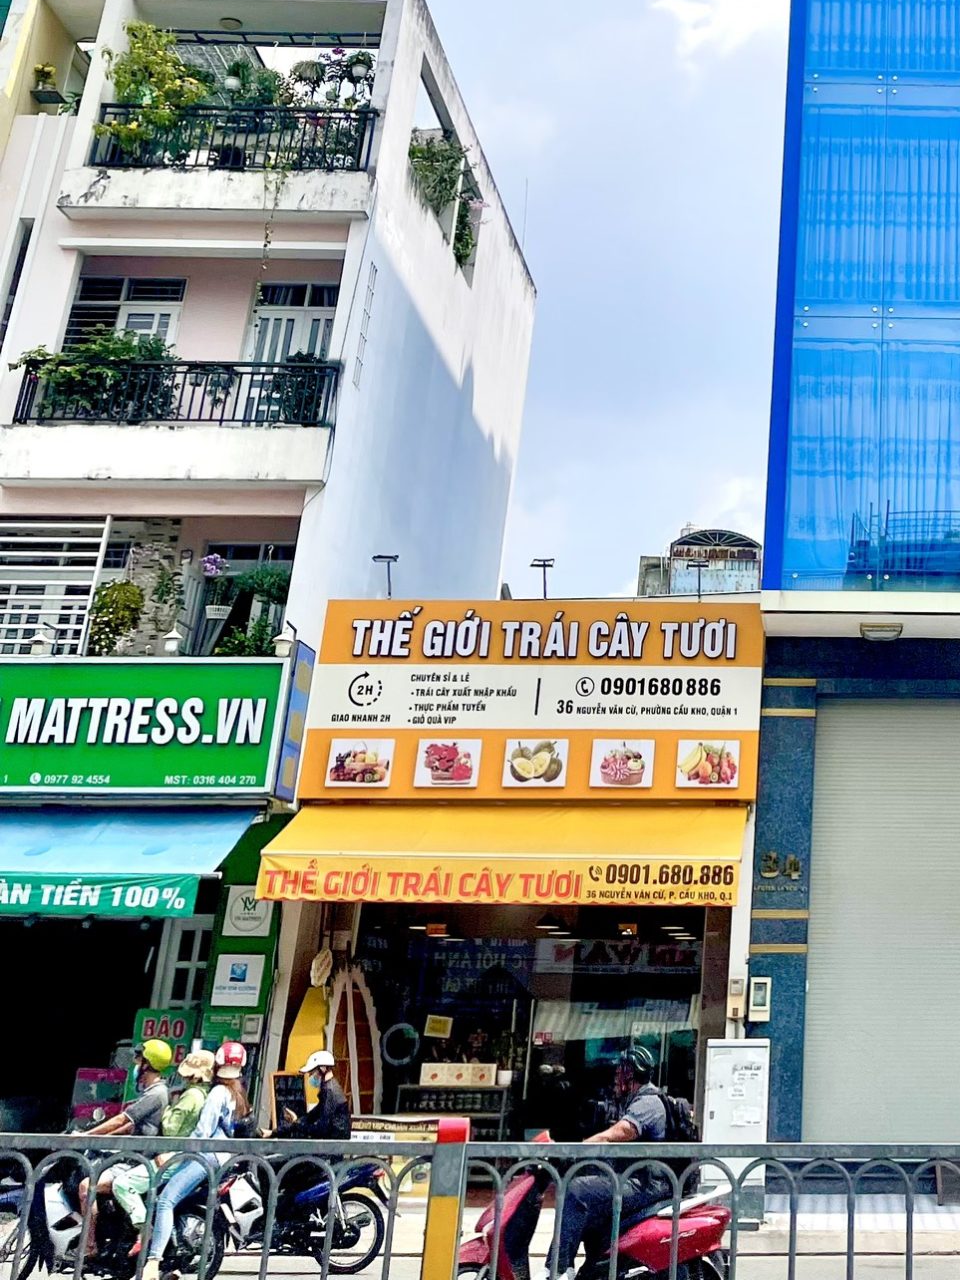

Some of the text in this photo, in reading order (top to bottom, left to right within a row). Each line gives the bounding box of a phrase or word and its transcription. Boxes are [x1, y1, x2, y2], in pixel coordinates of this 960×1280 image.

[352, 606, 737, 659] THẾ GIỚI TRÁI CÂY TƯƠI
[357, 684, 374, 695] 2H
[415, 686, 434, 697] TRÁI
[435, 687, 451, 697] CÂY
[556, 699, 574, 714] 36
[733, 707, 738, 716] 1
[5, 697, 268, 746] MATTRESS.VN
[331, 714, 391, 722] GIAO NHANH 2H
[443, 715, 457, 724] VIP
[44, 774, 111, 785] 0977 92 4554
[164, 774, 256, 785] MST: 0316 404 270
[605, 863, 734, 885] 0901.680.886
[323, 863, 381, 896] GIỚI
[387, 865, 453, 897] TRÁI
[458, 867, 515, 898] CÂY
[519, 869, 583, 899] TƯƠI
[40, 877, 102, 906] TIỀN
[111, 885, 186, 909] 100%
[586, 890, 597, 899] 36
[669, 891, 677, 899] P.
